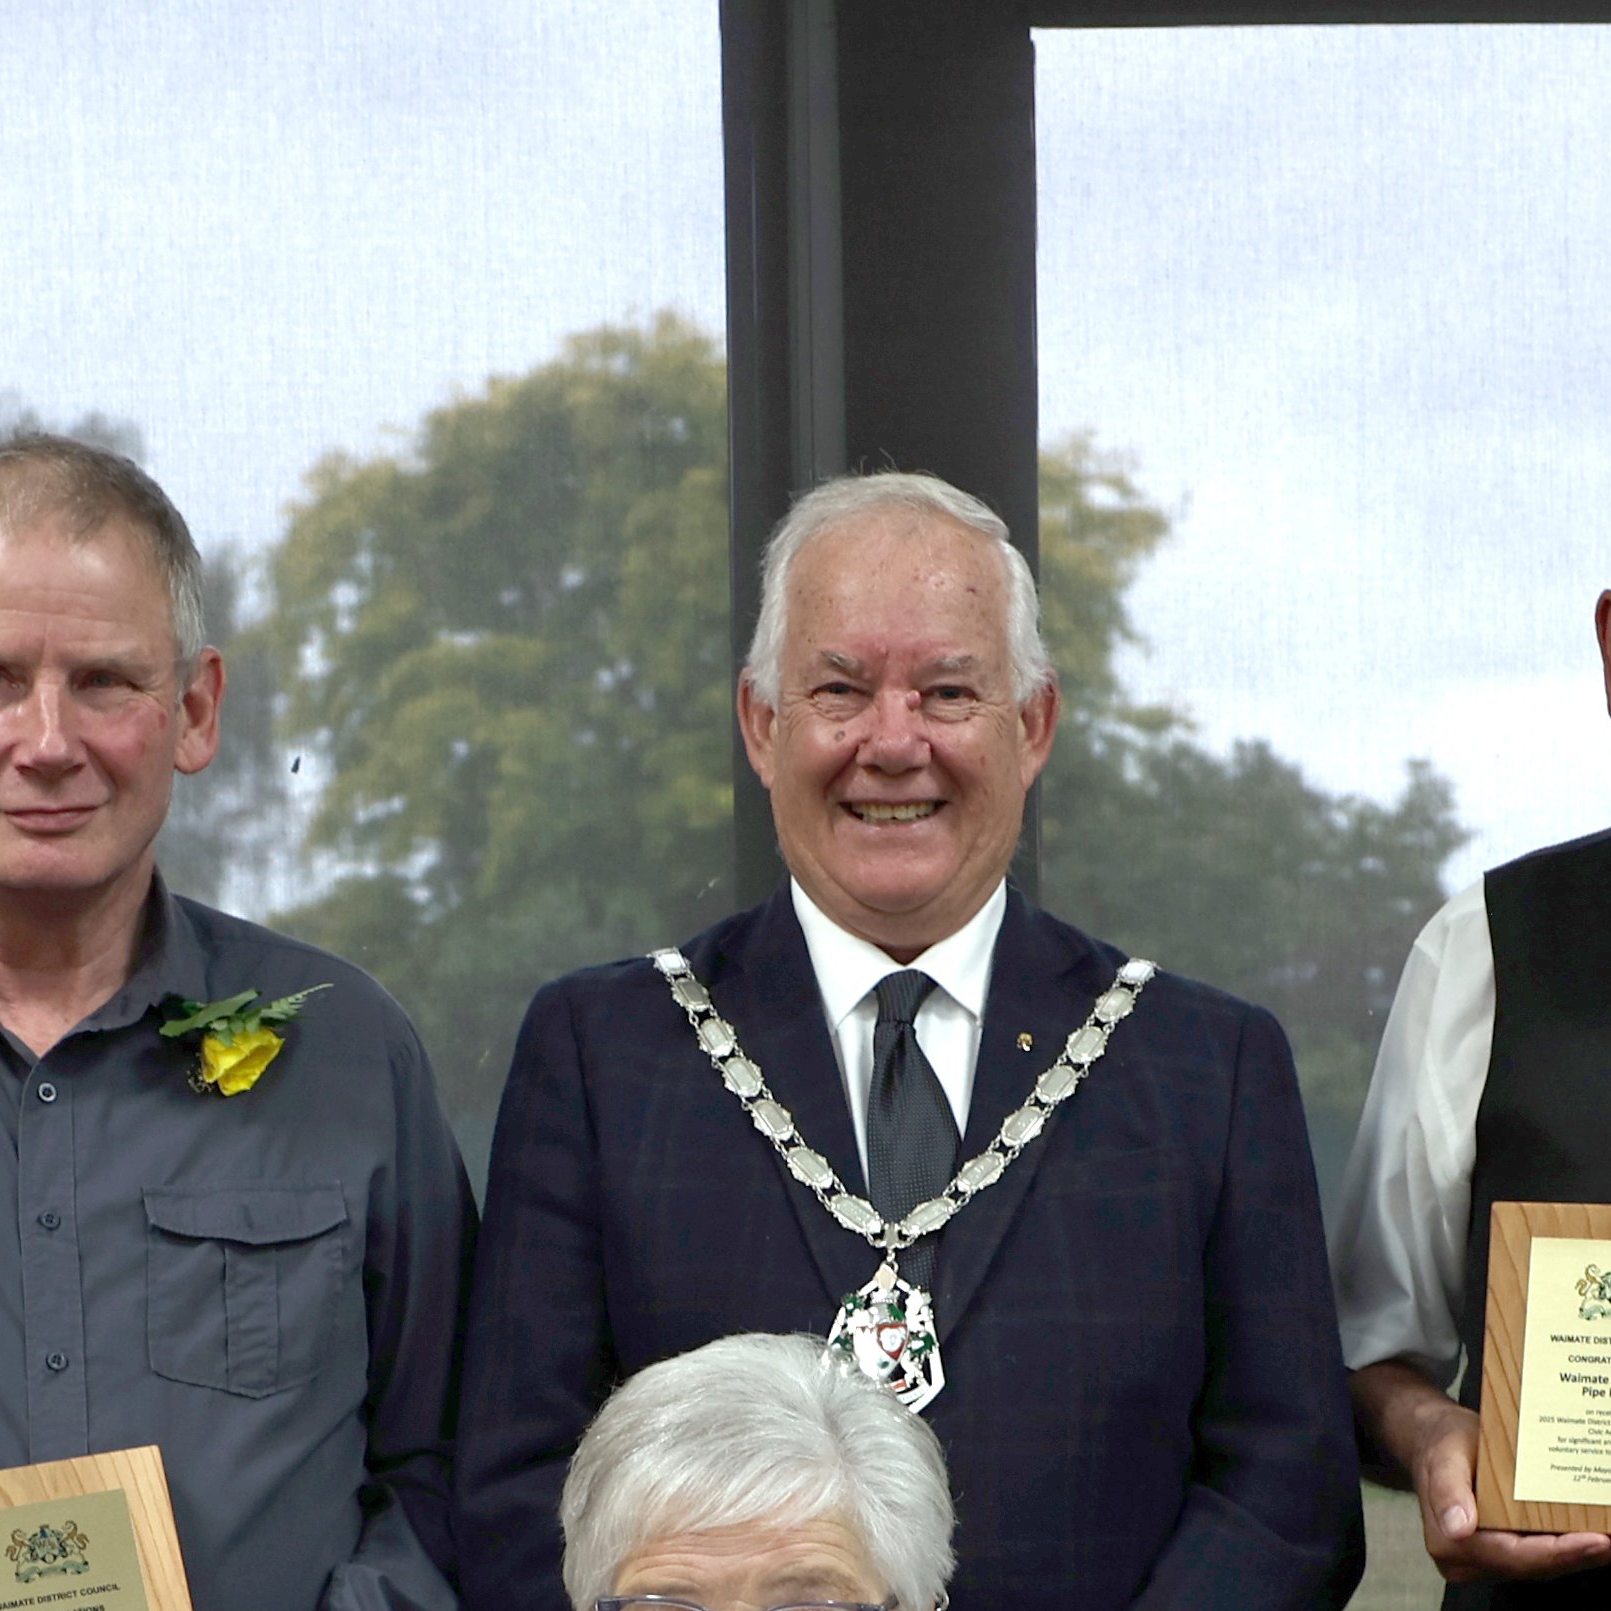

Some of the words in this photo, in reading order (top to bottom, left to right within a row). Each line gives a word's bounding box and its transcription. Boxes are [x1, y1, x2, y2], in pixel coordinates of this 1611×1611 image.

[1550, 1335, 1591, 1344] WAIMATE
[1559, 1372, 1609, 1384] Waimate
[1582, 1386, 1606, 1399] Pipe
[37, 1590, 77, 1604] DISTRICT
[79, 1584, 120, 1596] COUNCIL
